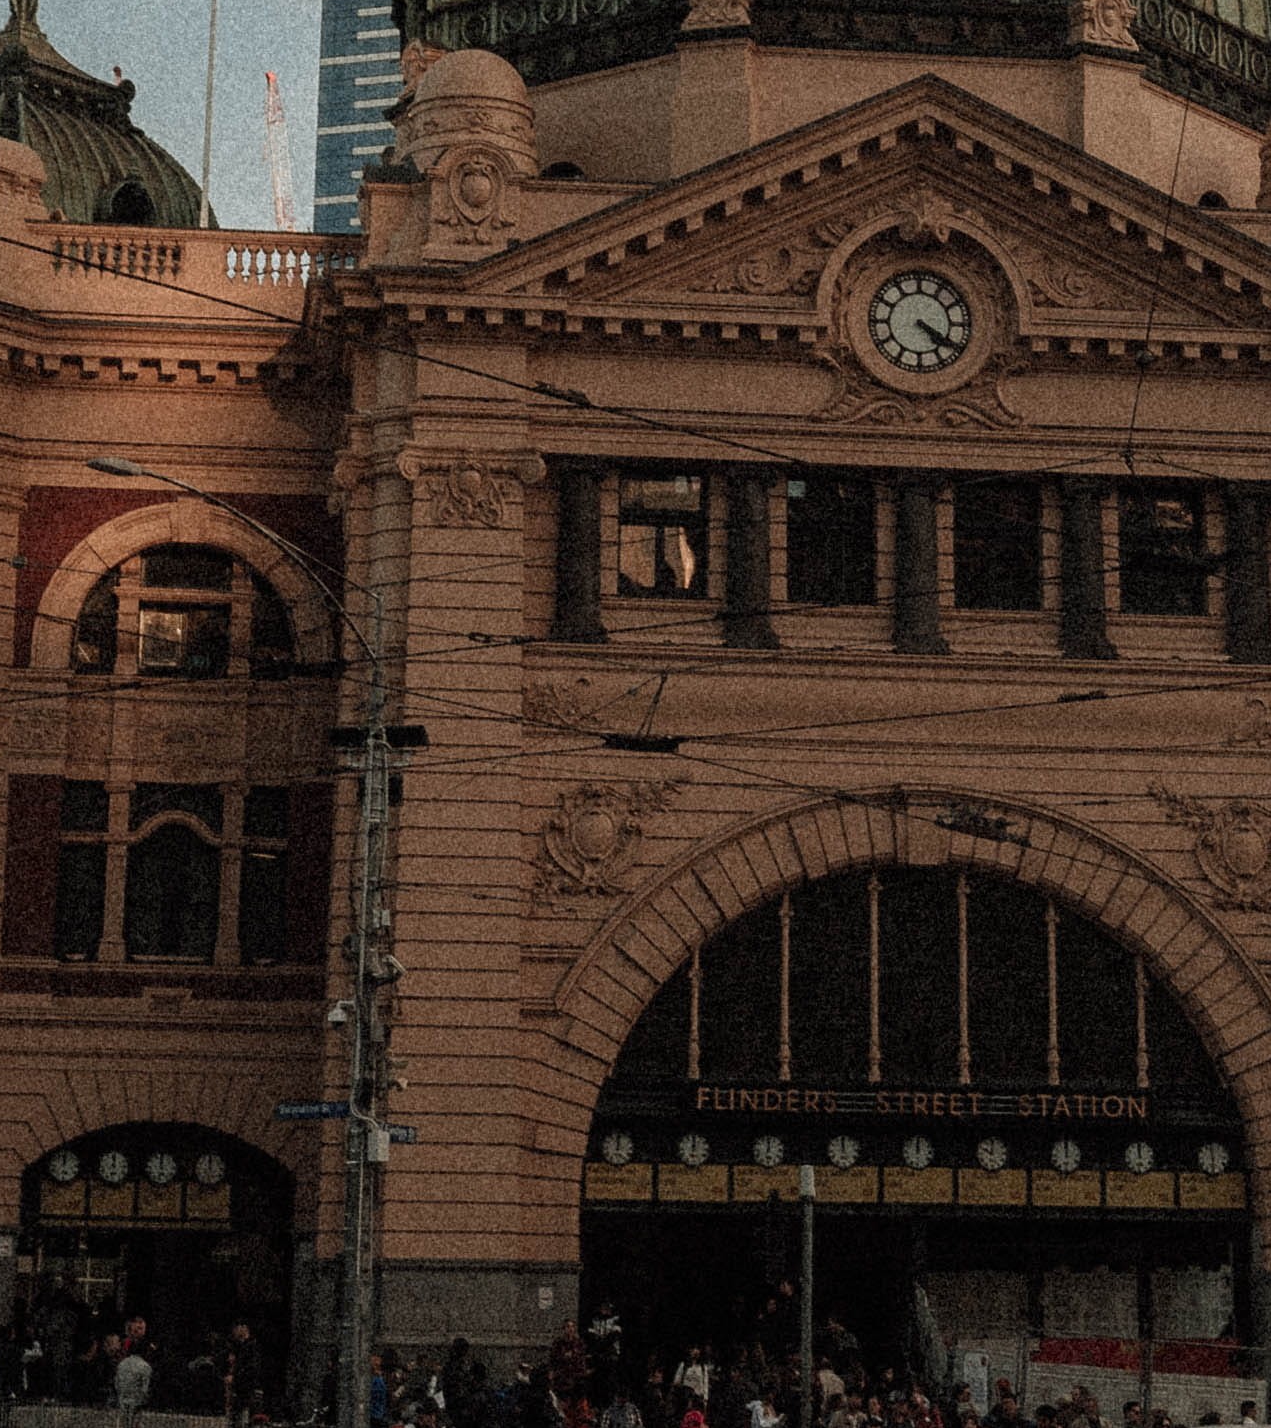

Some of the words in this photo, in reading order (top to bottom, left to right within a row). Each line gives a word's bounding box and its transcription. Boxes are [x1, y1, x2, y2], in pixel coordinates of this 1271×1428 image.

[695, 1085, 838, 1113] FLINDERS
[874, 1091, 986, 1116] STREET
[1016, 1093, 1148, 1119] STATION
